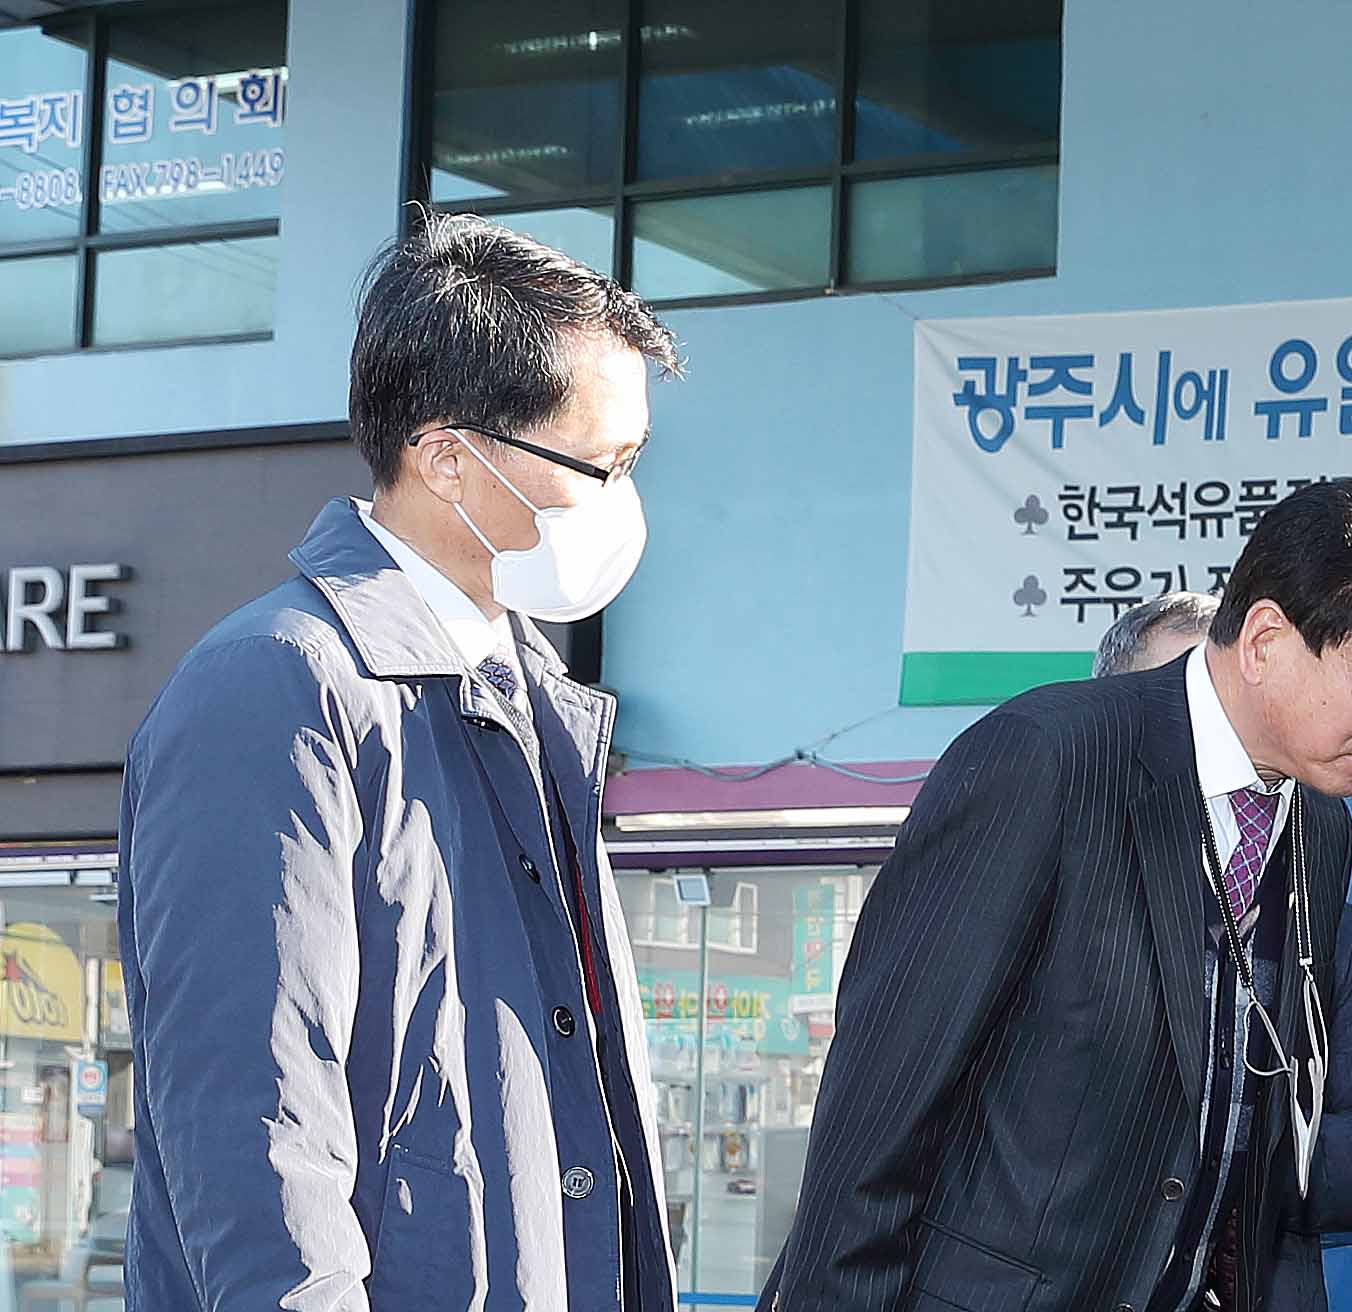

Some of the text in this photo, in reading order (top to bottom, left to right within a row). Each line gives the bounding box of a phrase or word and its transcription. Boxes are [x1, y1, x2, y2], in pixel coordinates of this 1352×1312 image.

[103, 165, 148, 199] FAX
[953, 350, 1229, 453] 광주시에
[0, 563, 121, 651] RE
